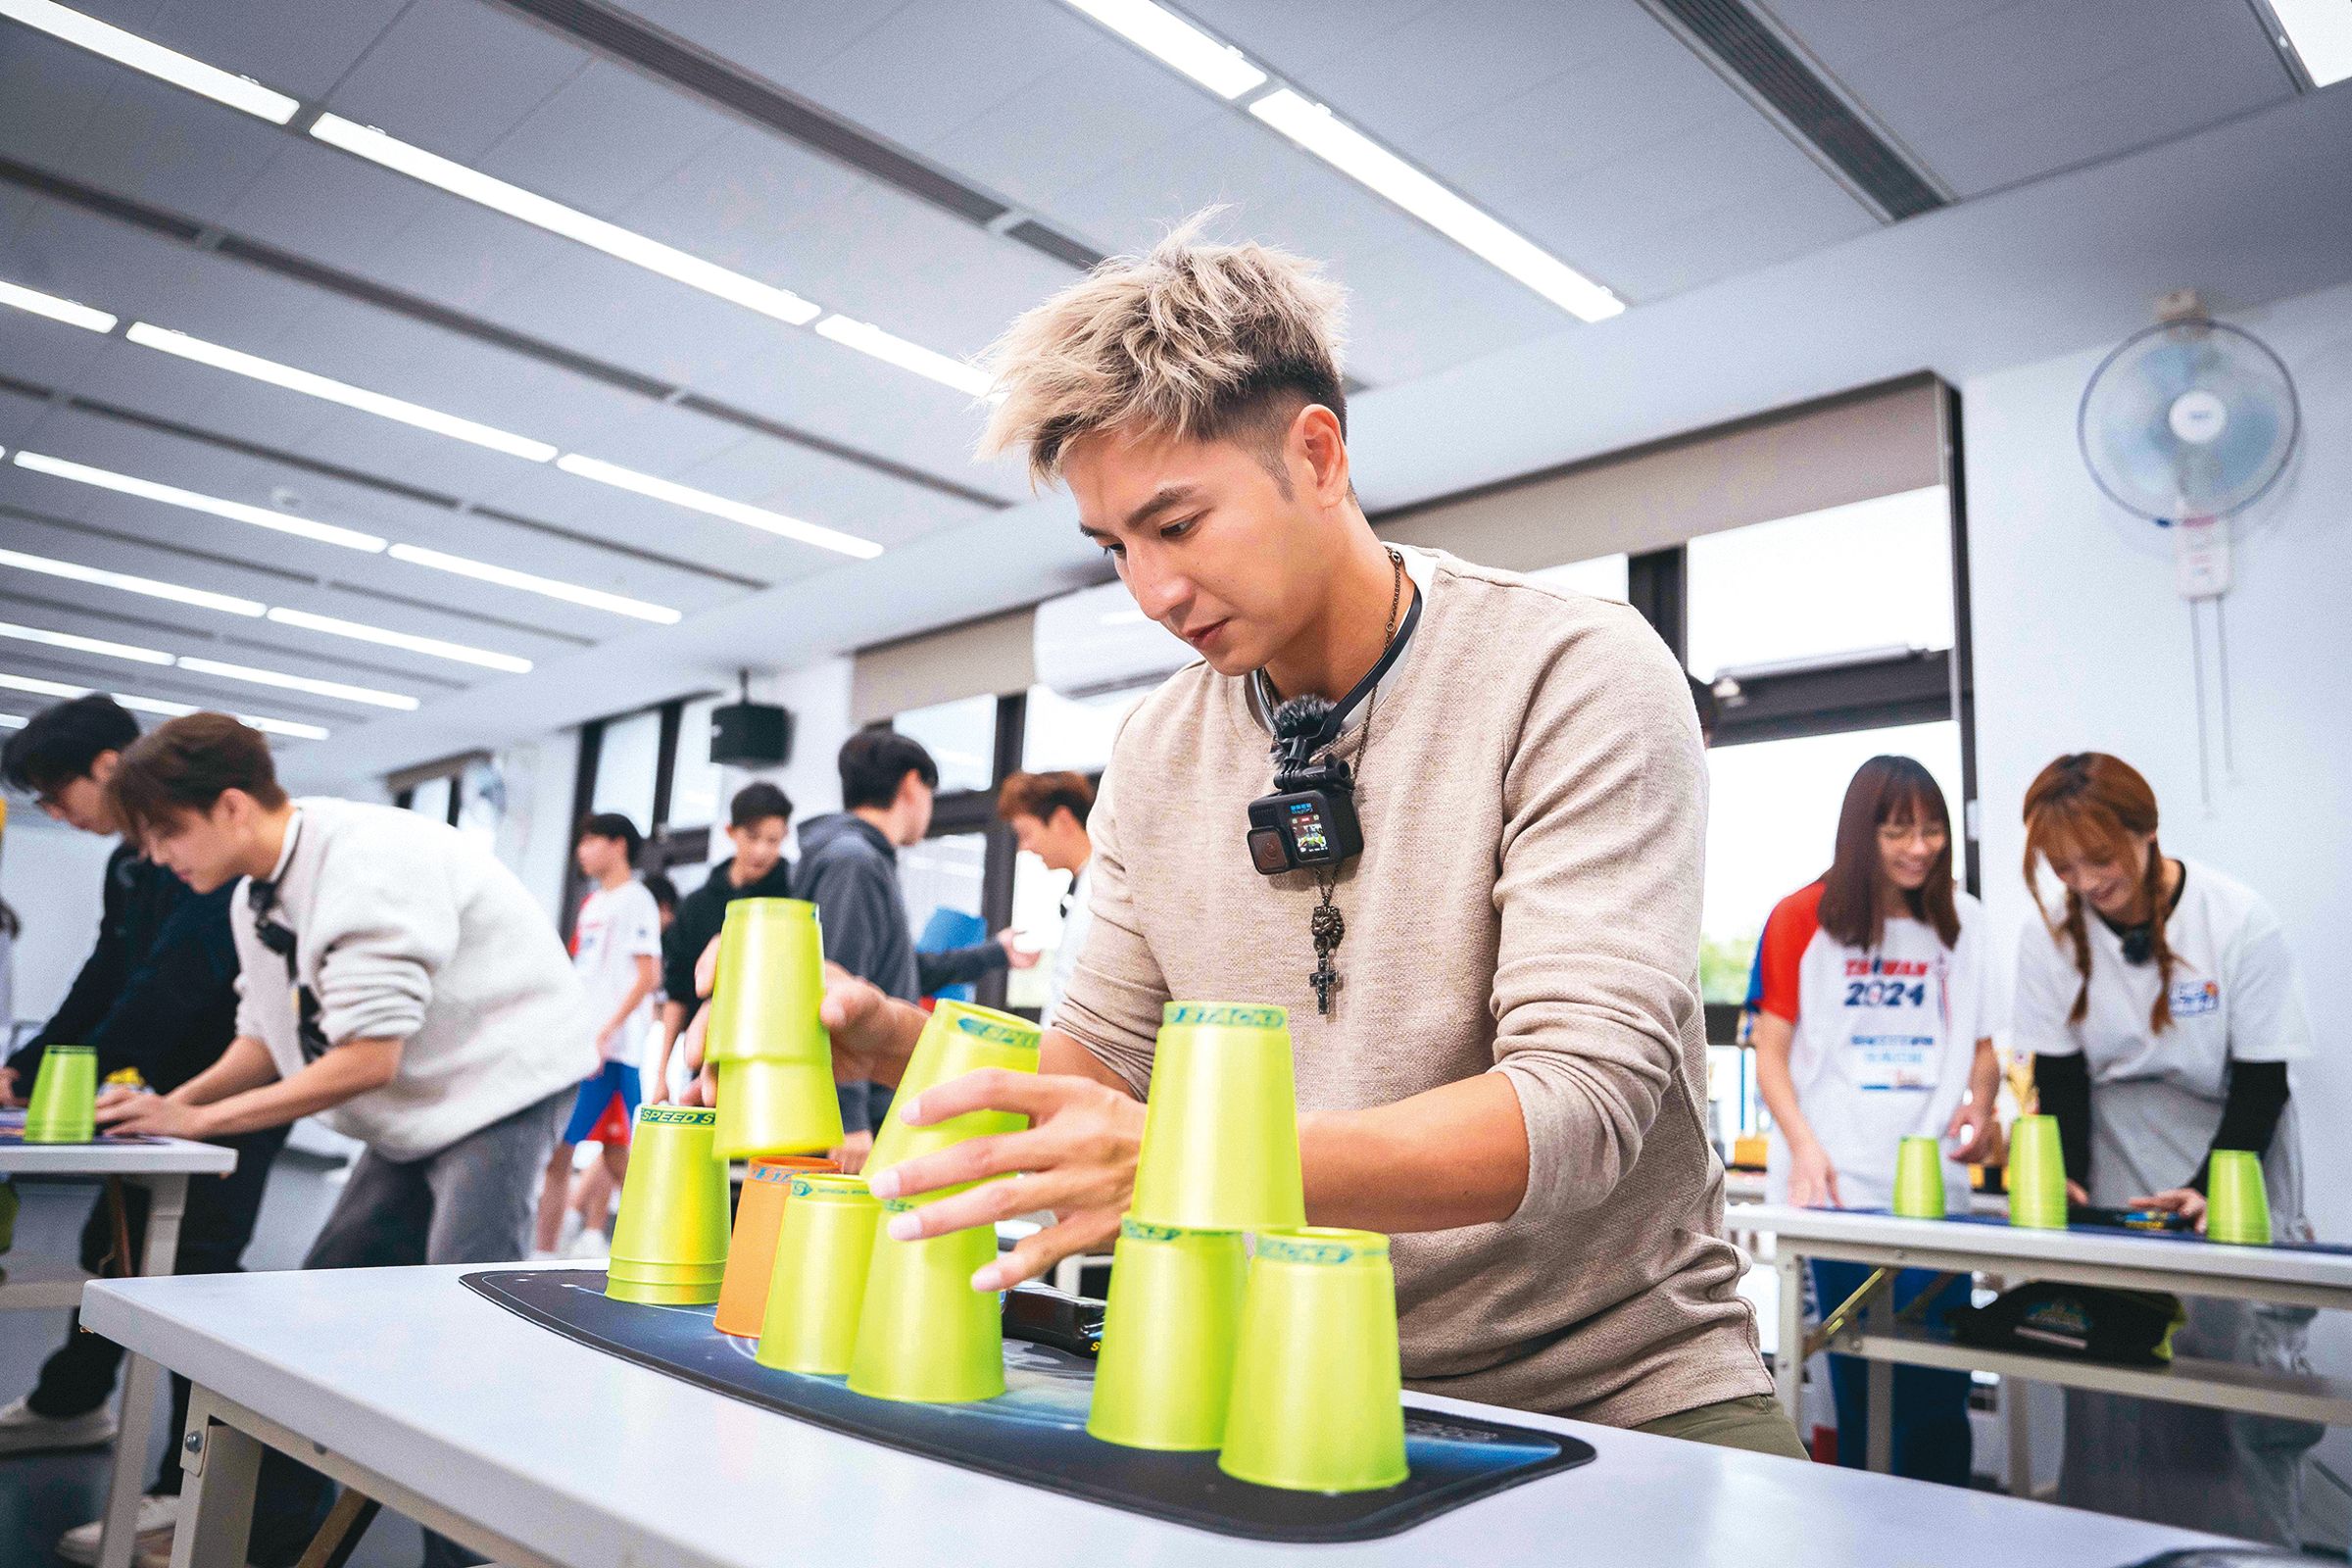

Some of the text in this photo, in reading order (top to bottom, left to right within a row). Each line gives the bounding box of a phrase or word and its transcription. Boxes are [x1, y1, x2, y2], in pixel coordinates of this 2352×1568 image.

[1843, 981, 1926, 1006] 2024
[642, 1110, 714, 1124] SPEED S
